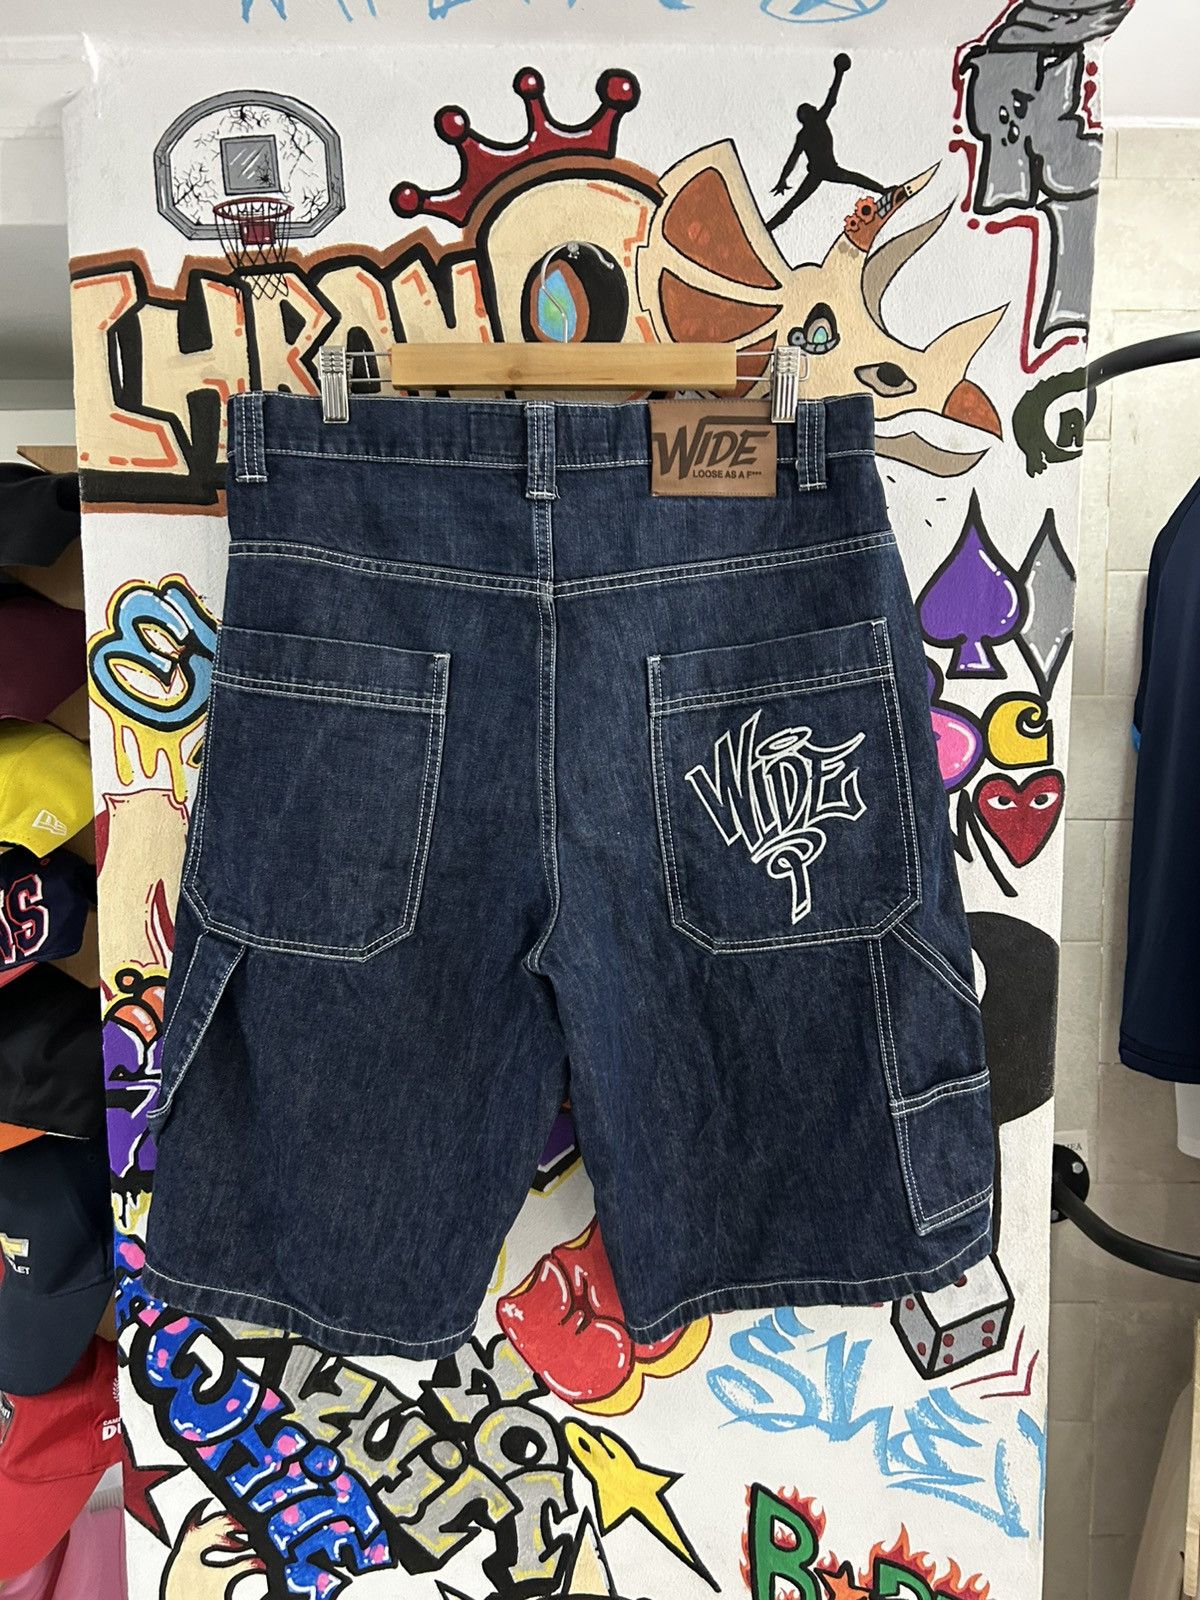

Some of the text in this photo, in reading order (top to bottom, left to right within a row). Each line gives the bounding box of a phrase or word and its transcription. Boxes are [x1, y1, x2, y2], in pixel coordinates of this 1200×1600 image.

[652, 415, 771, 480] WIDE
[693, 469, 723, 479] LOOSE
[724, 470, 737, 480] AS
[738, 471, 745, 479] A
[0, 874, 49, 965] S
